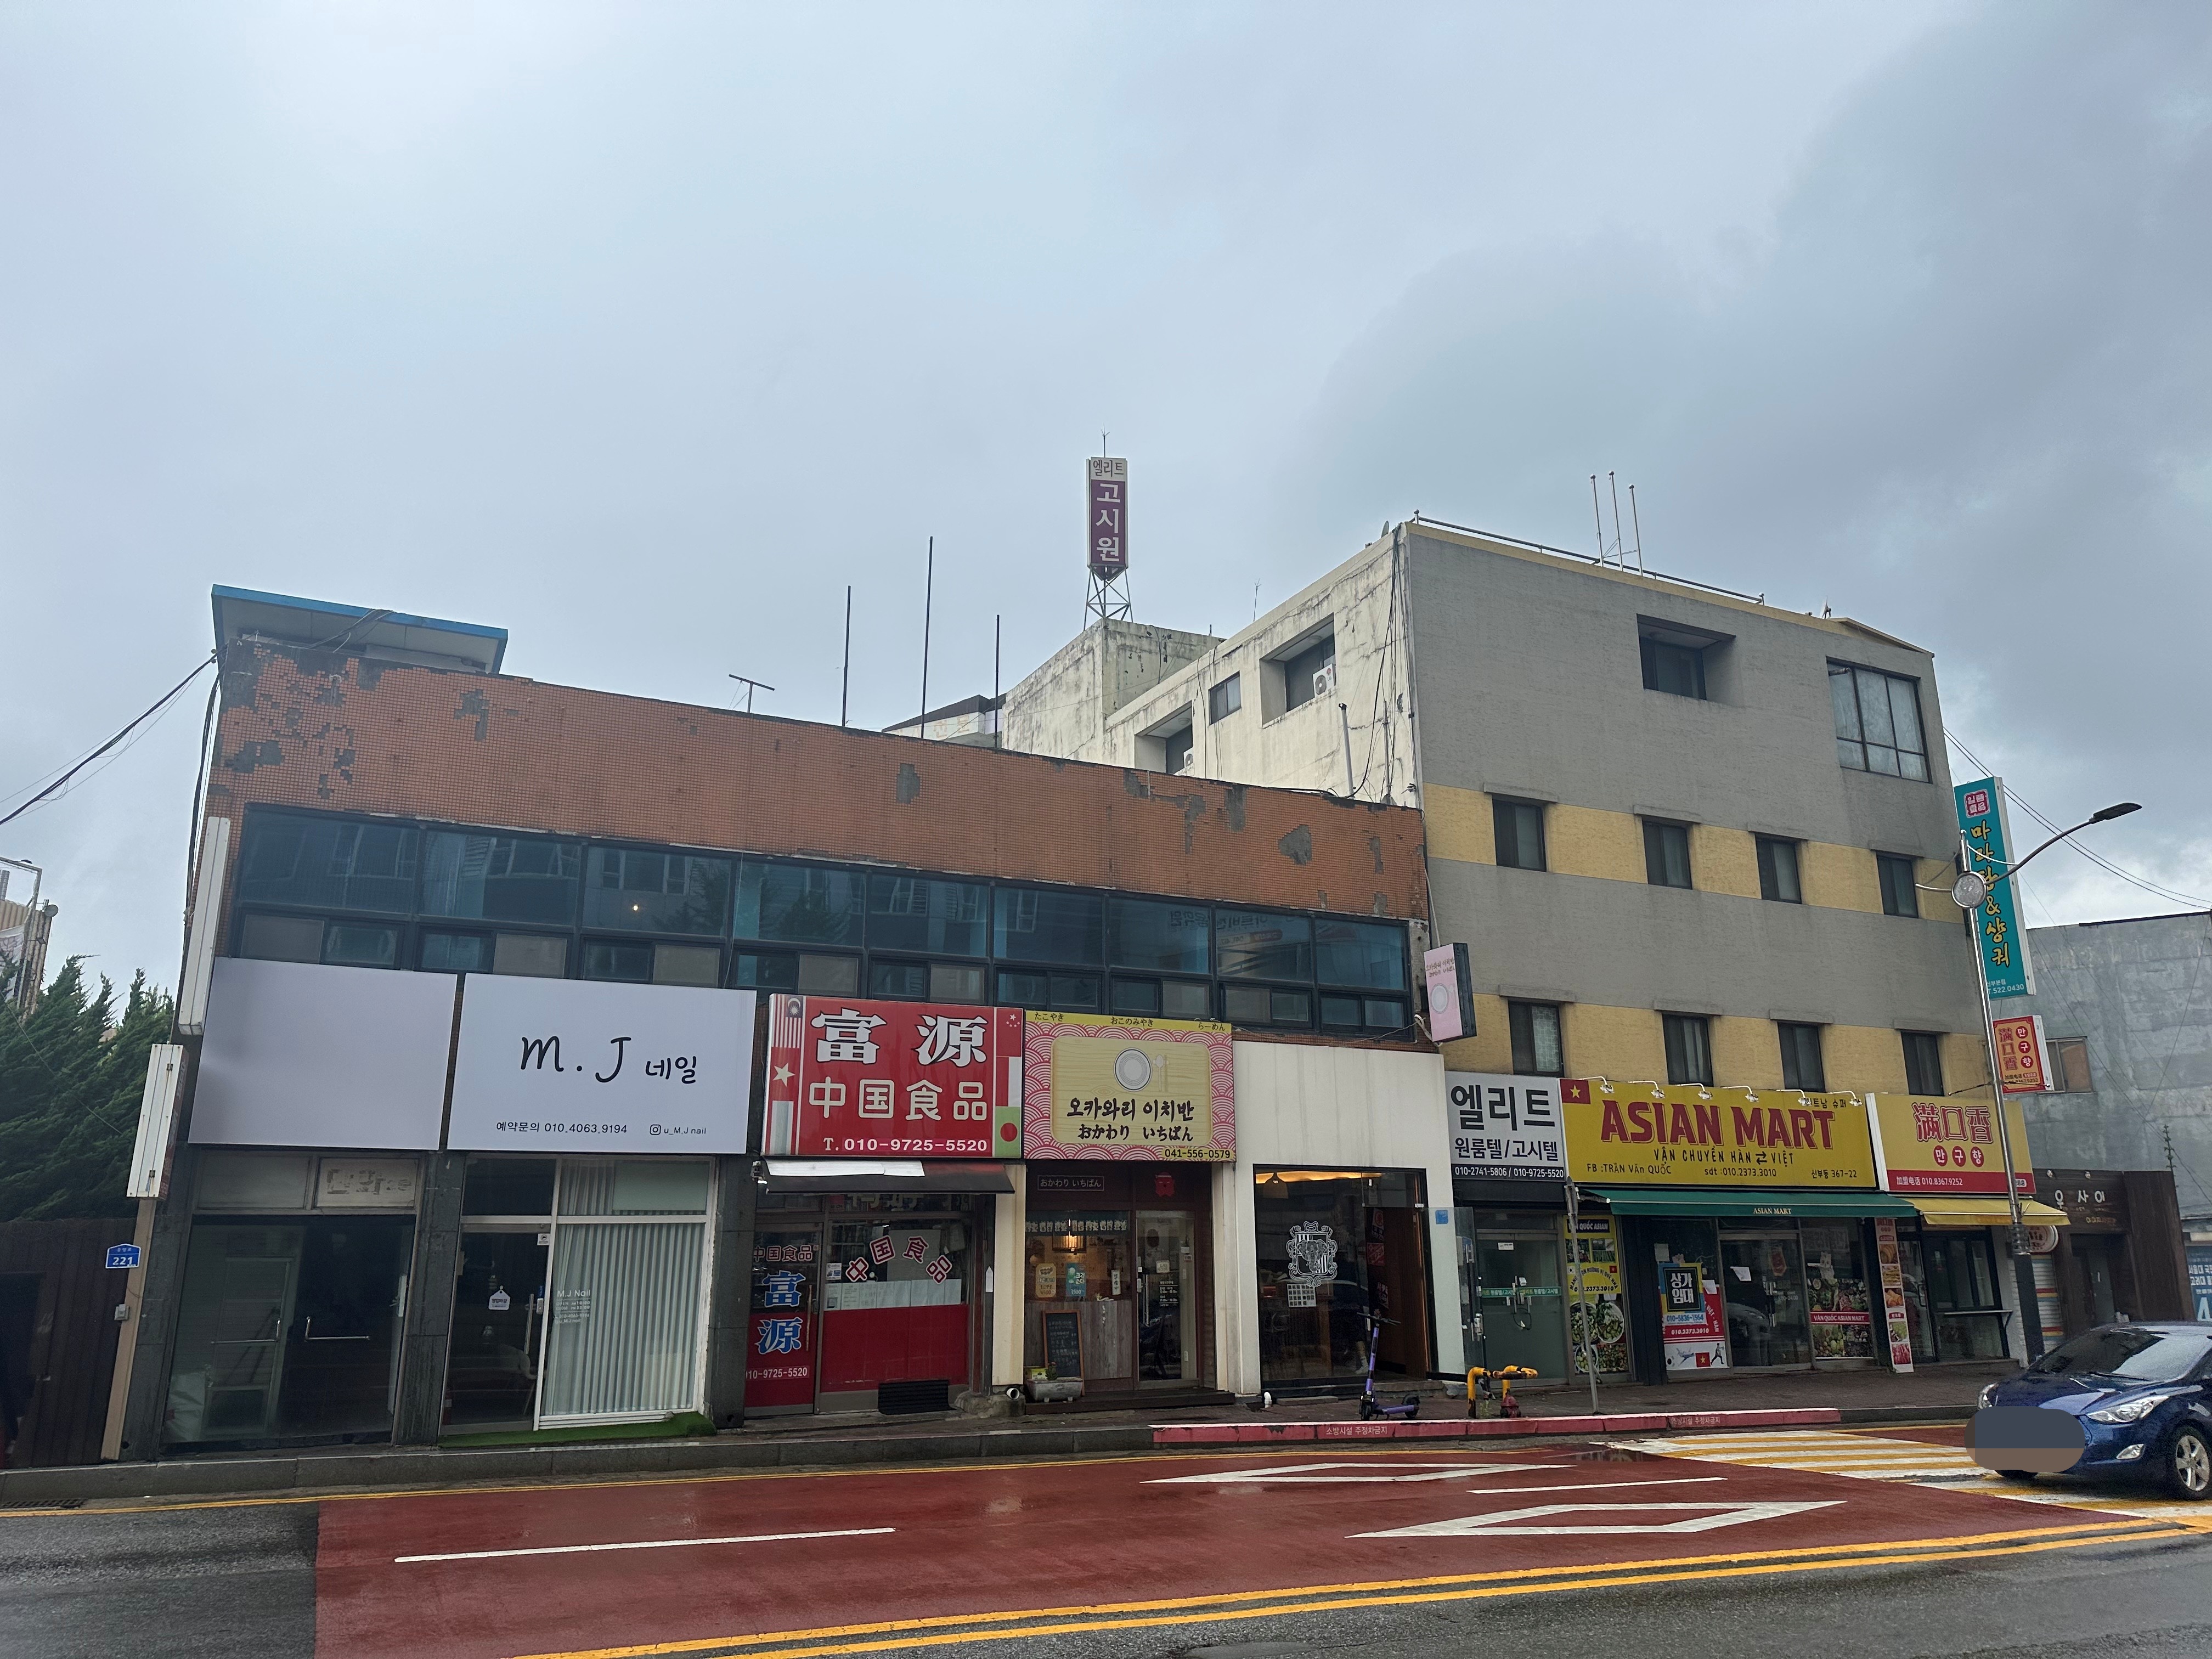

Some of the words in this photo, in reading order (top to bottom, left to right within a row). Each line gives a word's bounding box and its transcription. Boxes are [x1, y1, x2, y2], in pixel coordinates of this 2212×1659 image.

[1093, 459, 1124, 477] 엘리트
[1096, 483, 1121, 562] 고시원
[1035, 1012, 1064, 1022] たこやき
[810, 1007, 988, 1067] 富源
[645, 1056, 697, 1084] 네일
[809, 1076, 988, 1121] 中国食品
[1809, 1098, 1827, 1109] 트남
[1832, 1099, 1847, 1109] 슈퍼
[1066, 1097, 1136, 1121] 오카와리
[1143, 1099, 1194, 1122] 이치반
[1451, 1085, 1555, 1131] 엘리트
[496, 1122, 539, 1132] 예약문의
[545, 1123, 628, 1134] 010.4063.9194
[1601, 1099, 1724, 1146] ASIAN
[1730, 1105, 1836, 1150] MART
[1078, 1124, 1130, 1140] おかわり
[1143, 1126, 1194, 1142] いちばん
[1165, 1148, 1231, 1158] 041-556-0579
[1731, 1148, 1752, 1163] HÀN
[1771, 1153, 1793, 1167] VIỆT
[1934, 1149, 1982, 1164] 만구향
[1455, 1166, 1507, 1176] 010-2741-5806
[1514, 1169, 1564, 1178] 010-9725-5520
[1587, 1163, 1598, 1172] FB
[1705, 1167, 1718, 1176] sdt
[1811, 1169, 1829, 1180] 신부동
[1831, 1170, 1857, 1179] 367-22
[112, 1256, 133, 1266] 221
[1670, 1272, 1692, 1288] 상가
[574, 1289, 591, 1297] Nail
[1672, 1288, 1695, 1304] 임대
[755, 1270, 806, 1355] 富源
[1326, 1426, 1352, 1436] 소방시설
[1355, 1425, 1387, 1435] 주정차금지
